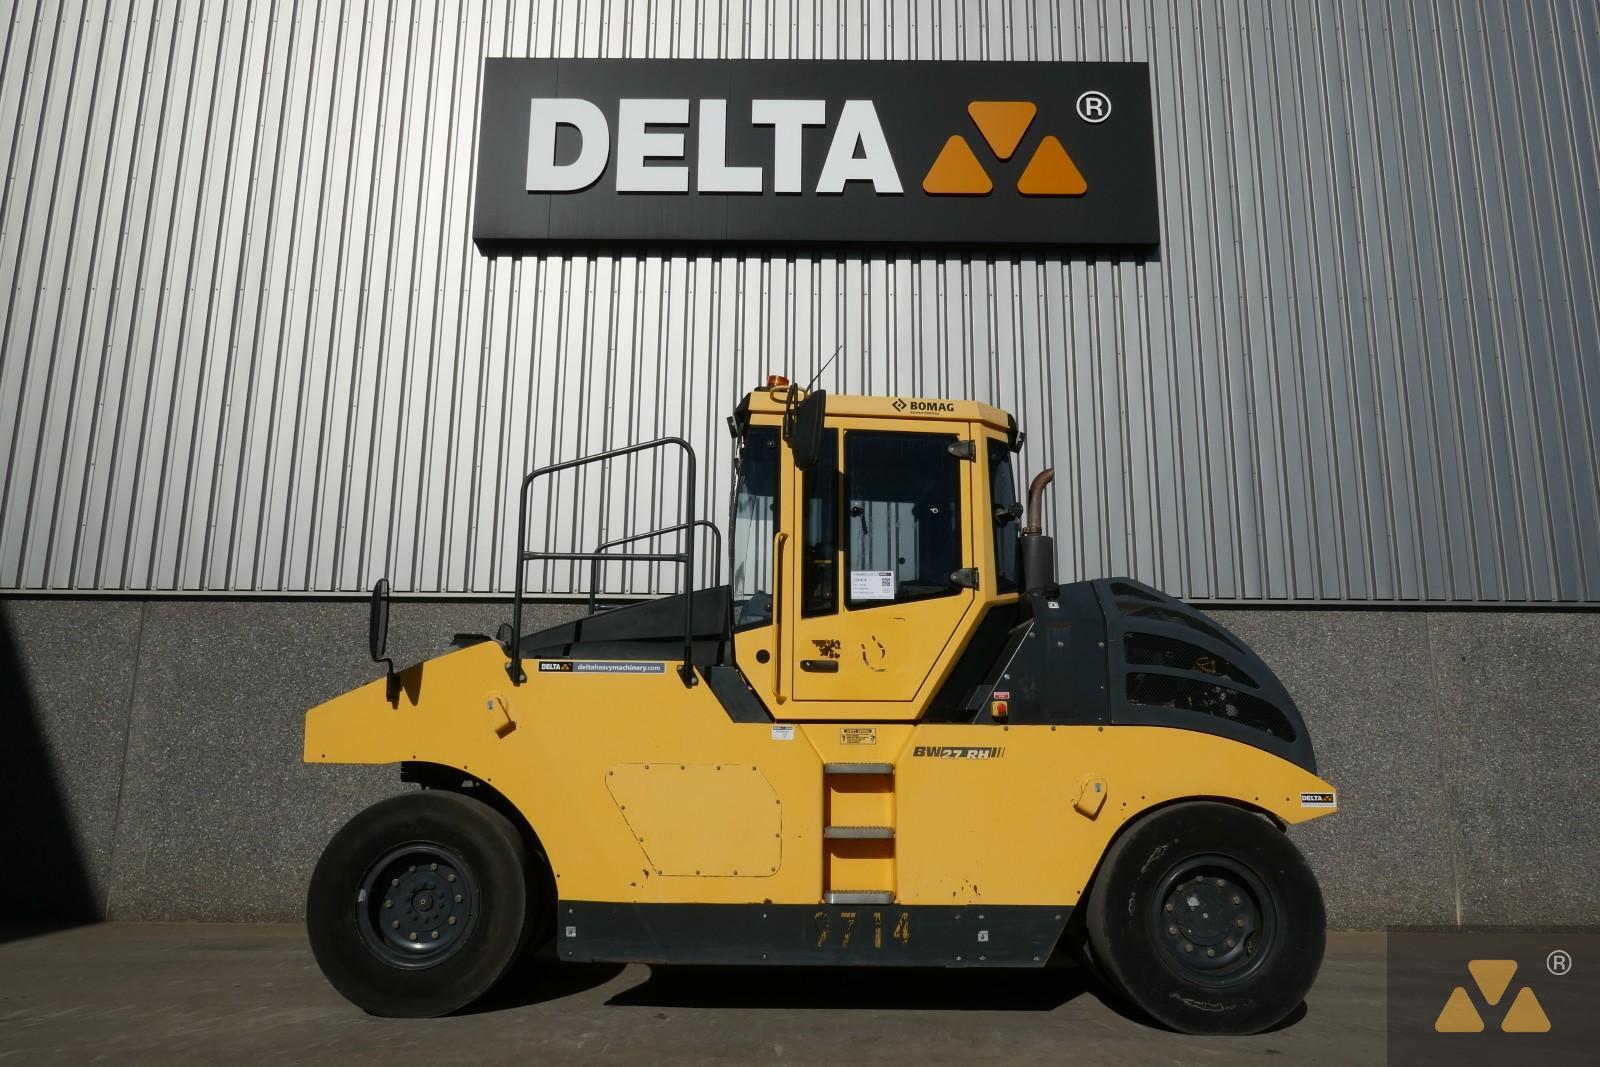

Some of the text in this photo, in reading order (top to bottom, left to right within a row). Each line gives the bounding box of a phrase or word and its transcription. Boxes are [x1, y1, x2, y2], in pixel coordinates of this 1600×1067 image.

[526, 98, 904, 194] DELTA
[910, 401, 955, 412] BOMAG
[577, 664, 661, 672] deltaheavymachinery.com
[966, 749, 990, 760] RH
